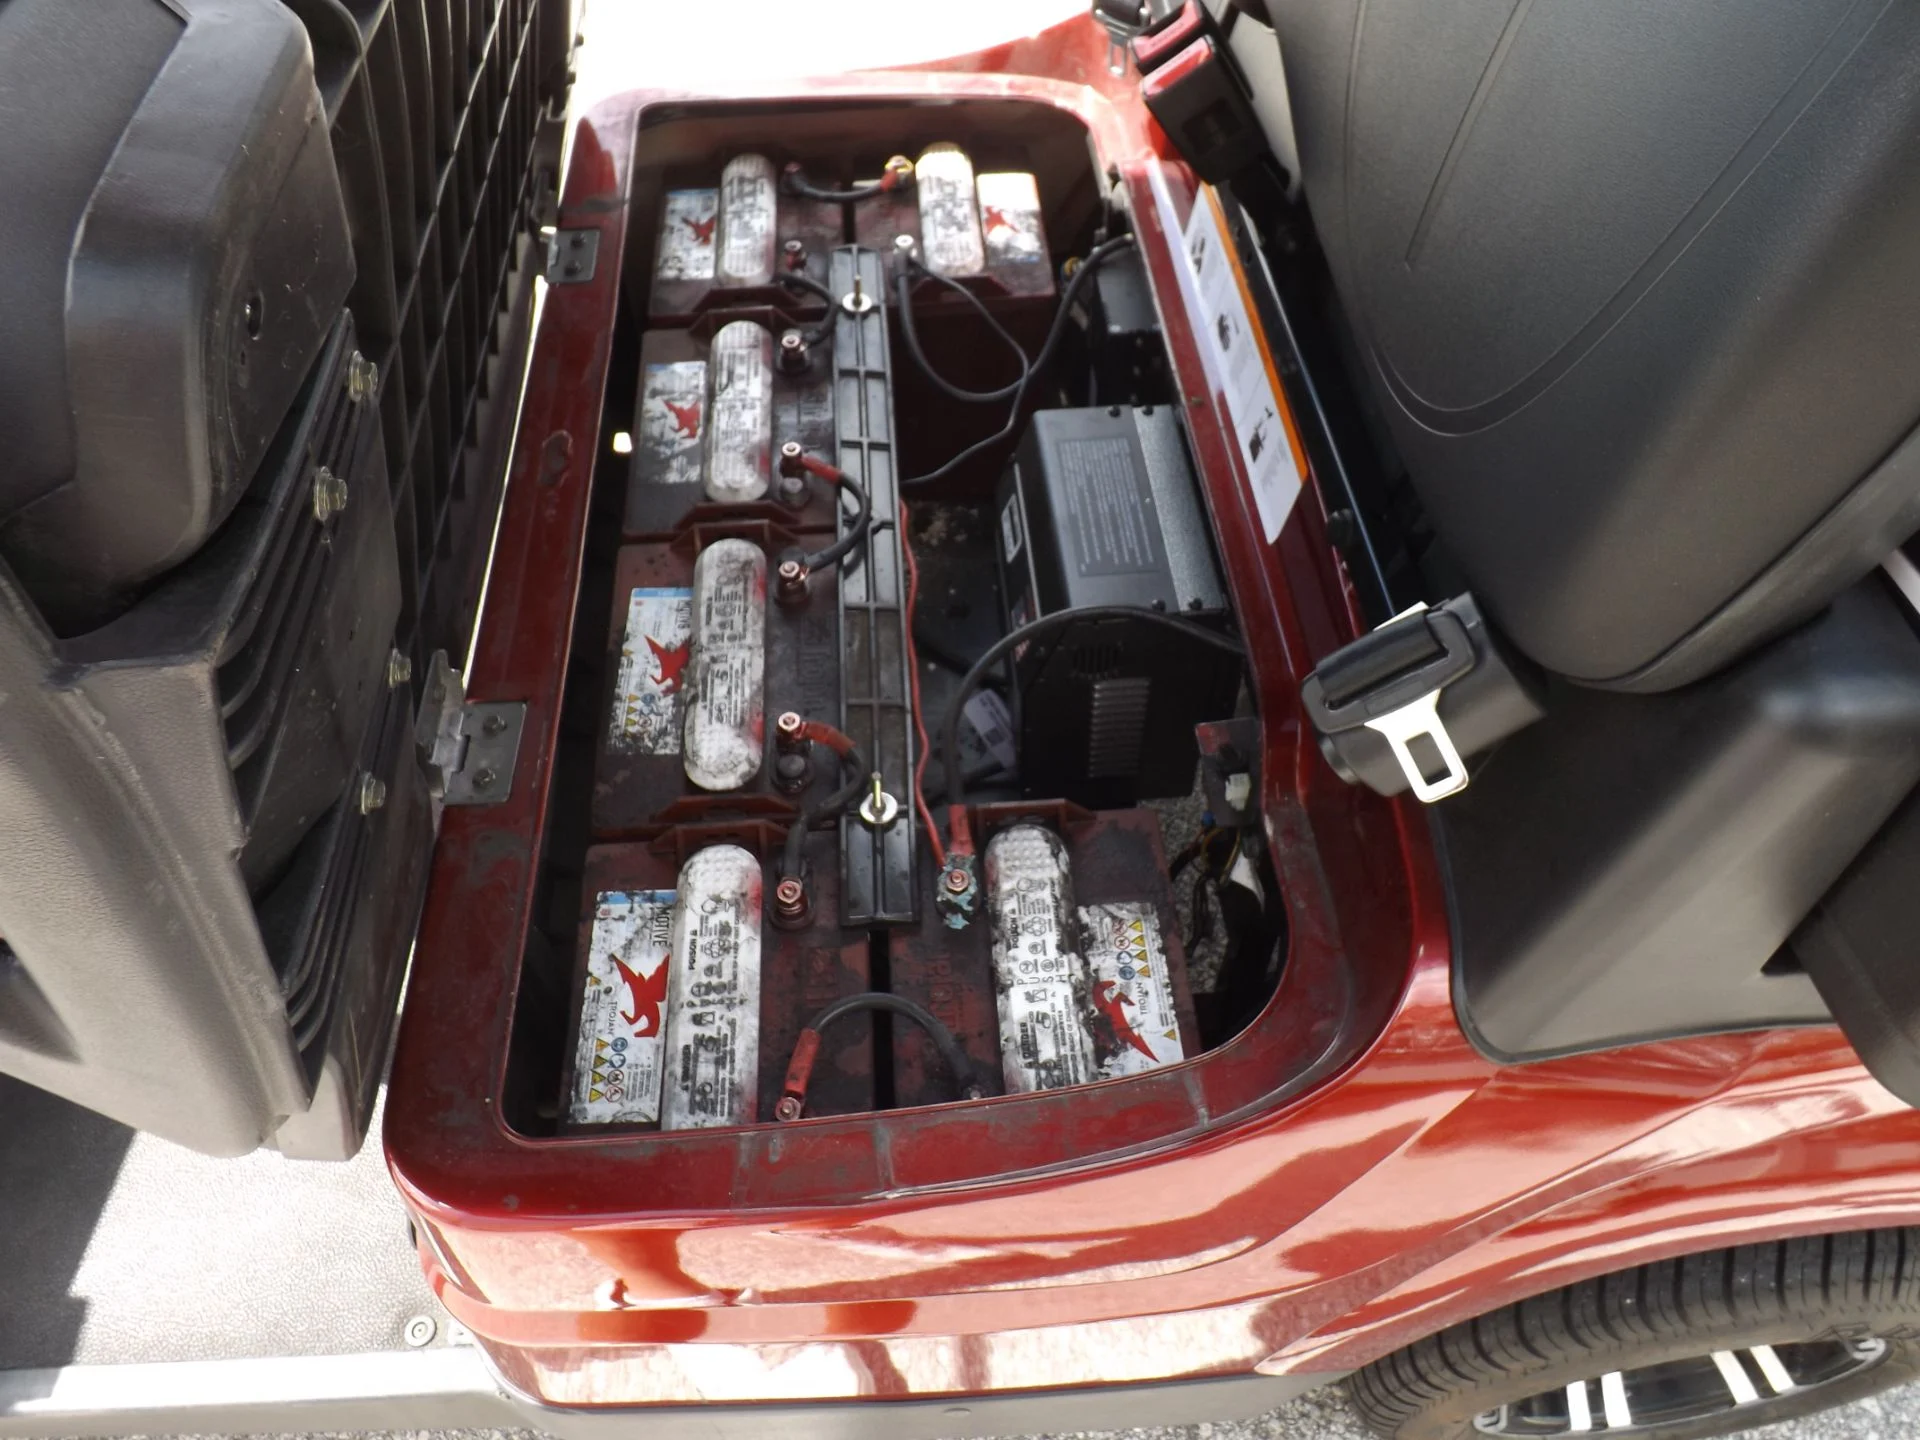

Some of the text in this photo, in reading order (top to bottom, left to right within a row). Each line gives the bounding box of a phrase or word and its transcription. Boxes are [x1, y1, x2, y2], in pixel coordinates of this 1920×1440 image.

[655, 905, 671, 946] MOTIVE
[688, 938, 697, 971] POISON
[1136, 982, 1148, 1015] TROJAN
[607, 1000, 618, 1035] TROJAN
